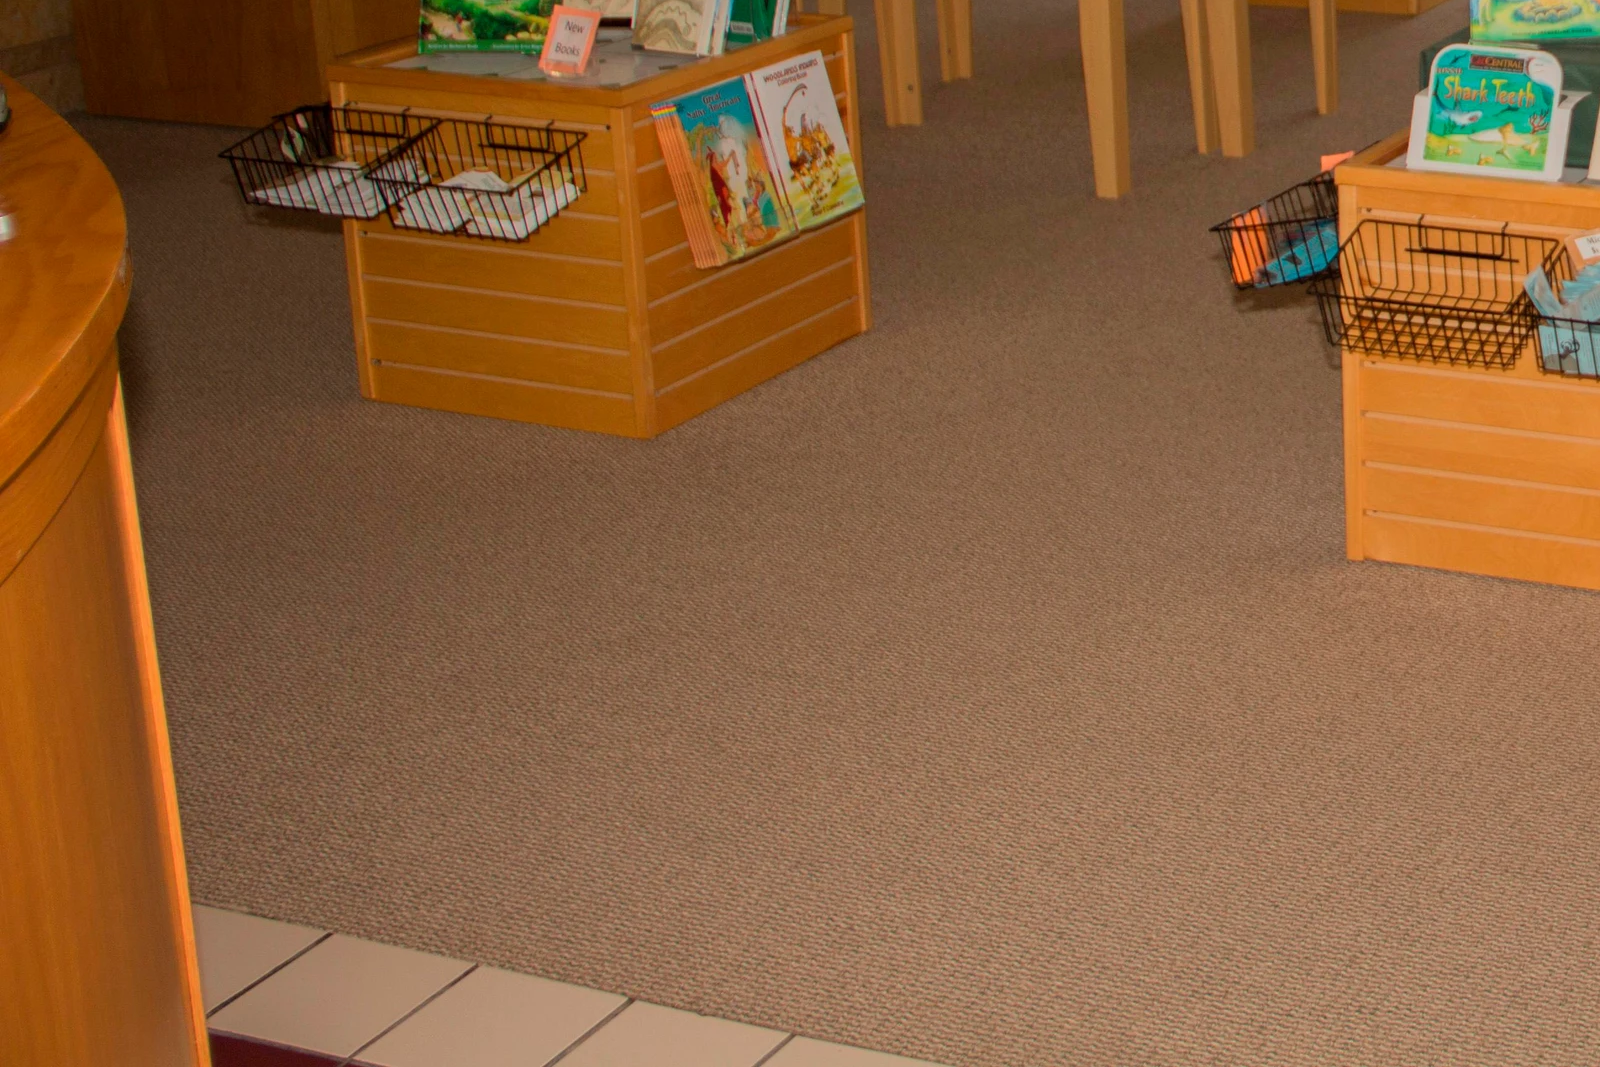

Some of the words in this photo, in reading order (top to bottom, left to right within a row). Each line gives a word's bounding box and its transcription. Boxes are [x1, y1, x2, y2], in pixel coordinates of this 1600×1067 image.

[564, 19, 585, 35] New
[554, 41, 581, 57] Books
[763, 65, 799, 84] WOODLANDS
[701, 91, 723, 105] Great
[1444, 75, 1488, 103] Shark
[1492, 78, 1536, 108] Teeth
[686, 108, 707, 121] Native
[708, 95, 742, 114] Americans
